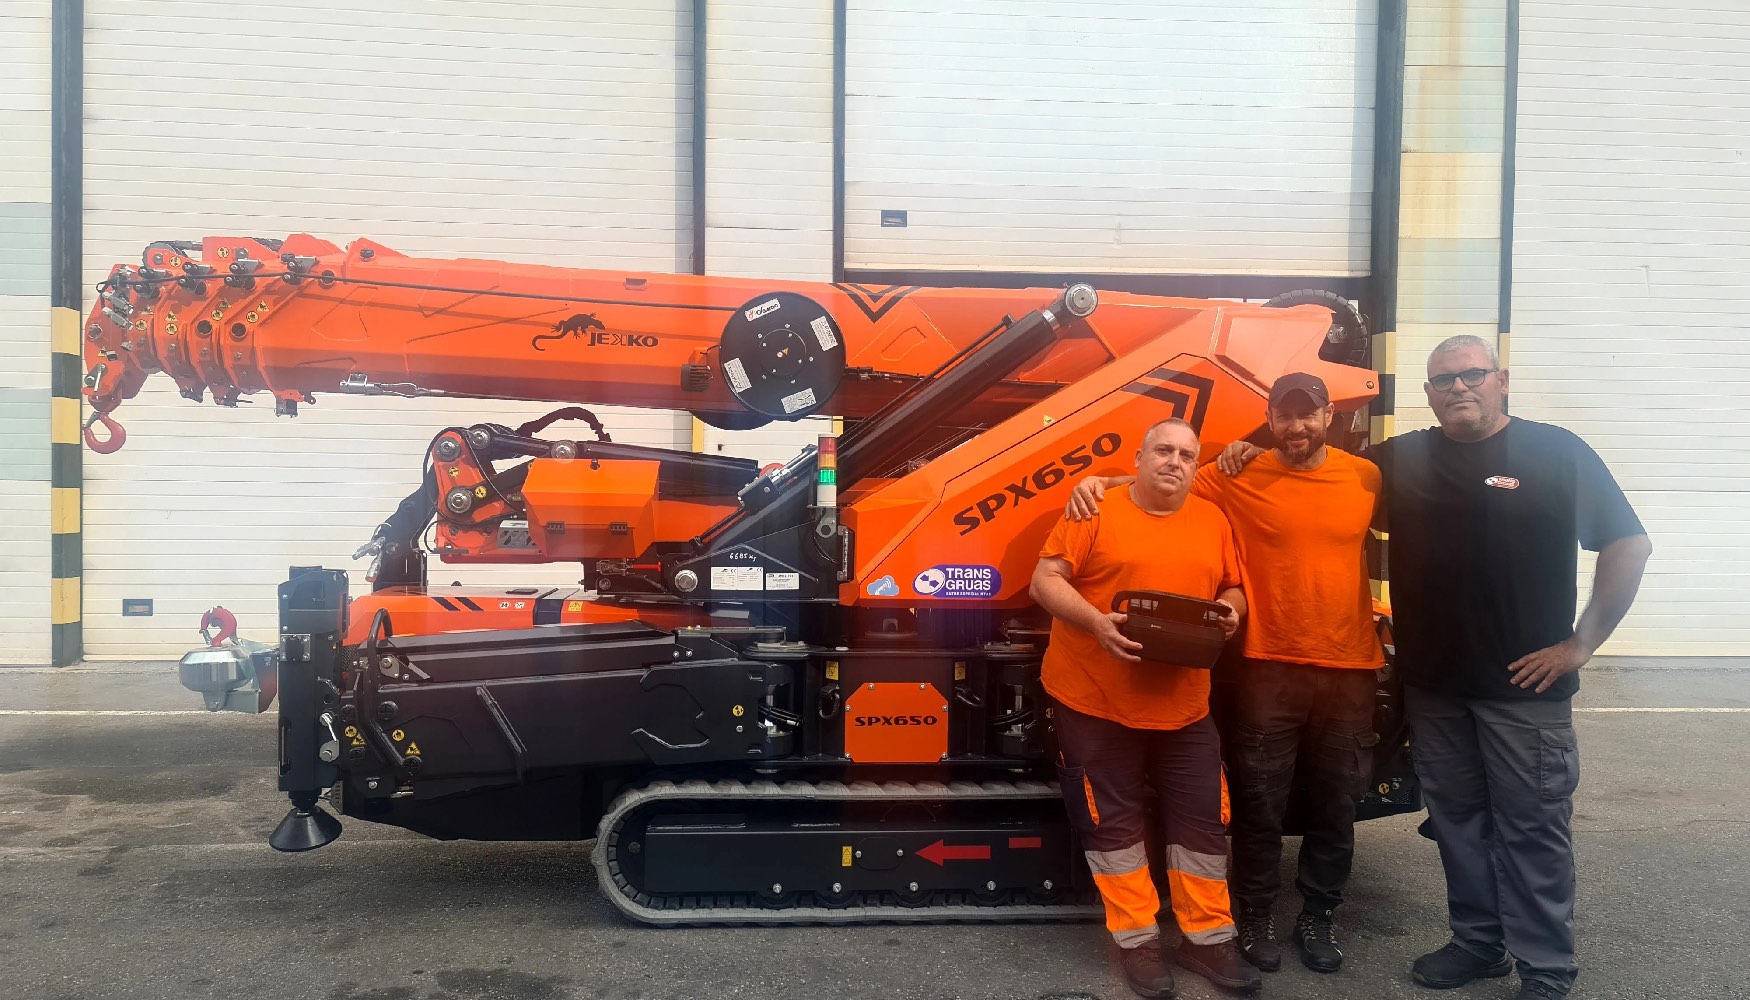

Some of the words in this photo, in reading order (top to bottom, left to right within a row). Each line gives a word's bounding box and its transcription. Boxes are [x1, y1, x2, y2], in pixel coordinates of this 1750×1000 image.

[587, 332, 659, 347] JEKKO
[953, 432, 1122, 537] SPX650
[854, 715, 938, 727] SPX650
